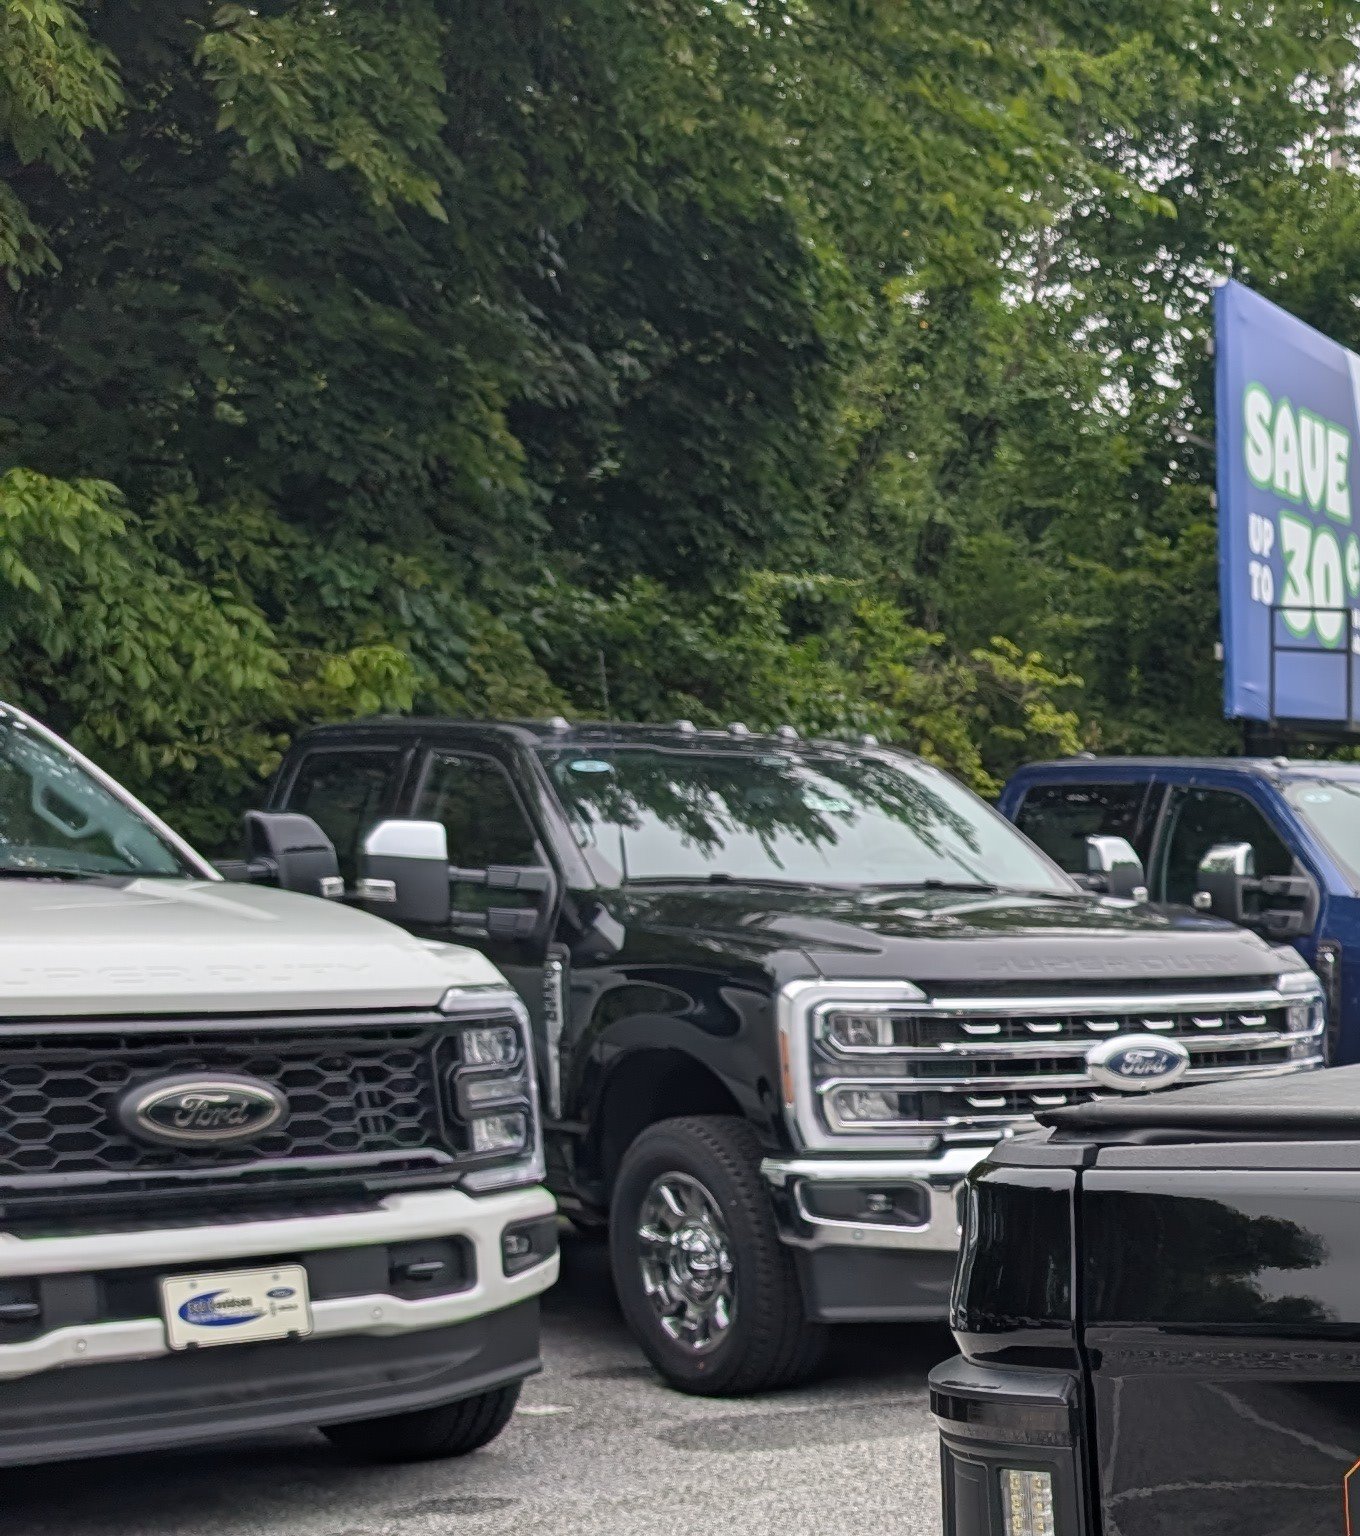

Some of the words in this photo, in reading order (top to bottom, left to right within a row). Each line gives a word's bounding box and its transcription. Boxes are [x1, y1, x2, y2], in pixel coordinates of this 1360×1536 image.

[1244, 382, 1352, 525] SAVE
[1249, 513, 1274, 559] UP
[1249, 560, 1274, 606] TO
[1121, 1051, 1168, 1074] Ford
[173, 1093, 250, 1127] Ford
